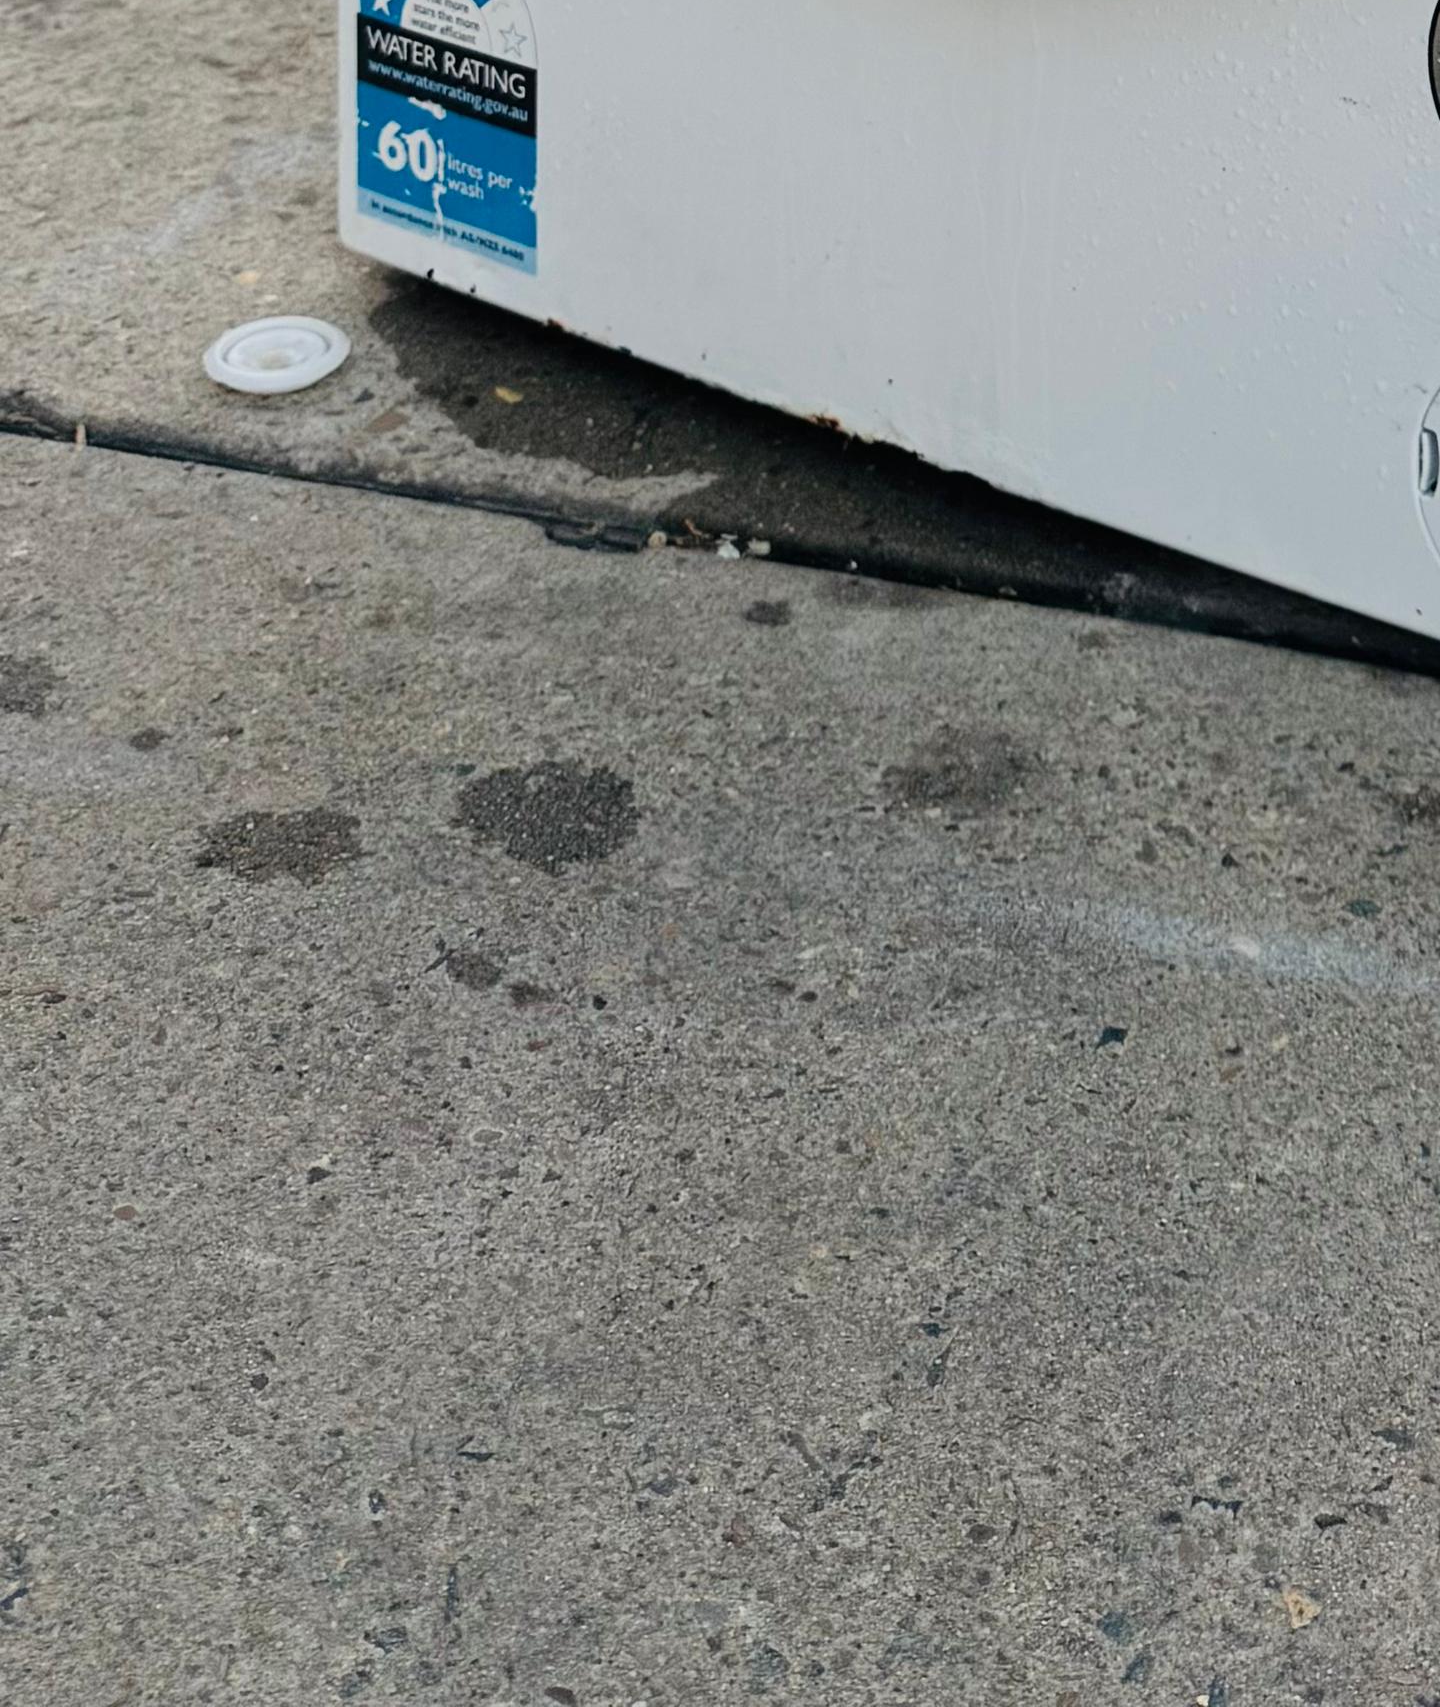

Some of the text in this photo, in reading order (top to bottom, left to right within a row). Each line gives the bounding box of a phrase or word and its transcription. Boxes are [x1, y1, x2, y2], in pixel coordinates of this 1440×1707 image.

[411, 17, 437, 33] water
[413, 3, 481, 33] stars the more
[366, 25, 527, 100] WATER RATING
[367, 58, 529, 123] www.waterrating.gov.au
[378, 120, 438, 182] 60
[447, 151, 513, 190] litres per
[446, 177, 485, 201] wash
